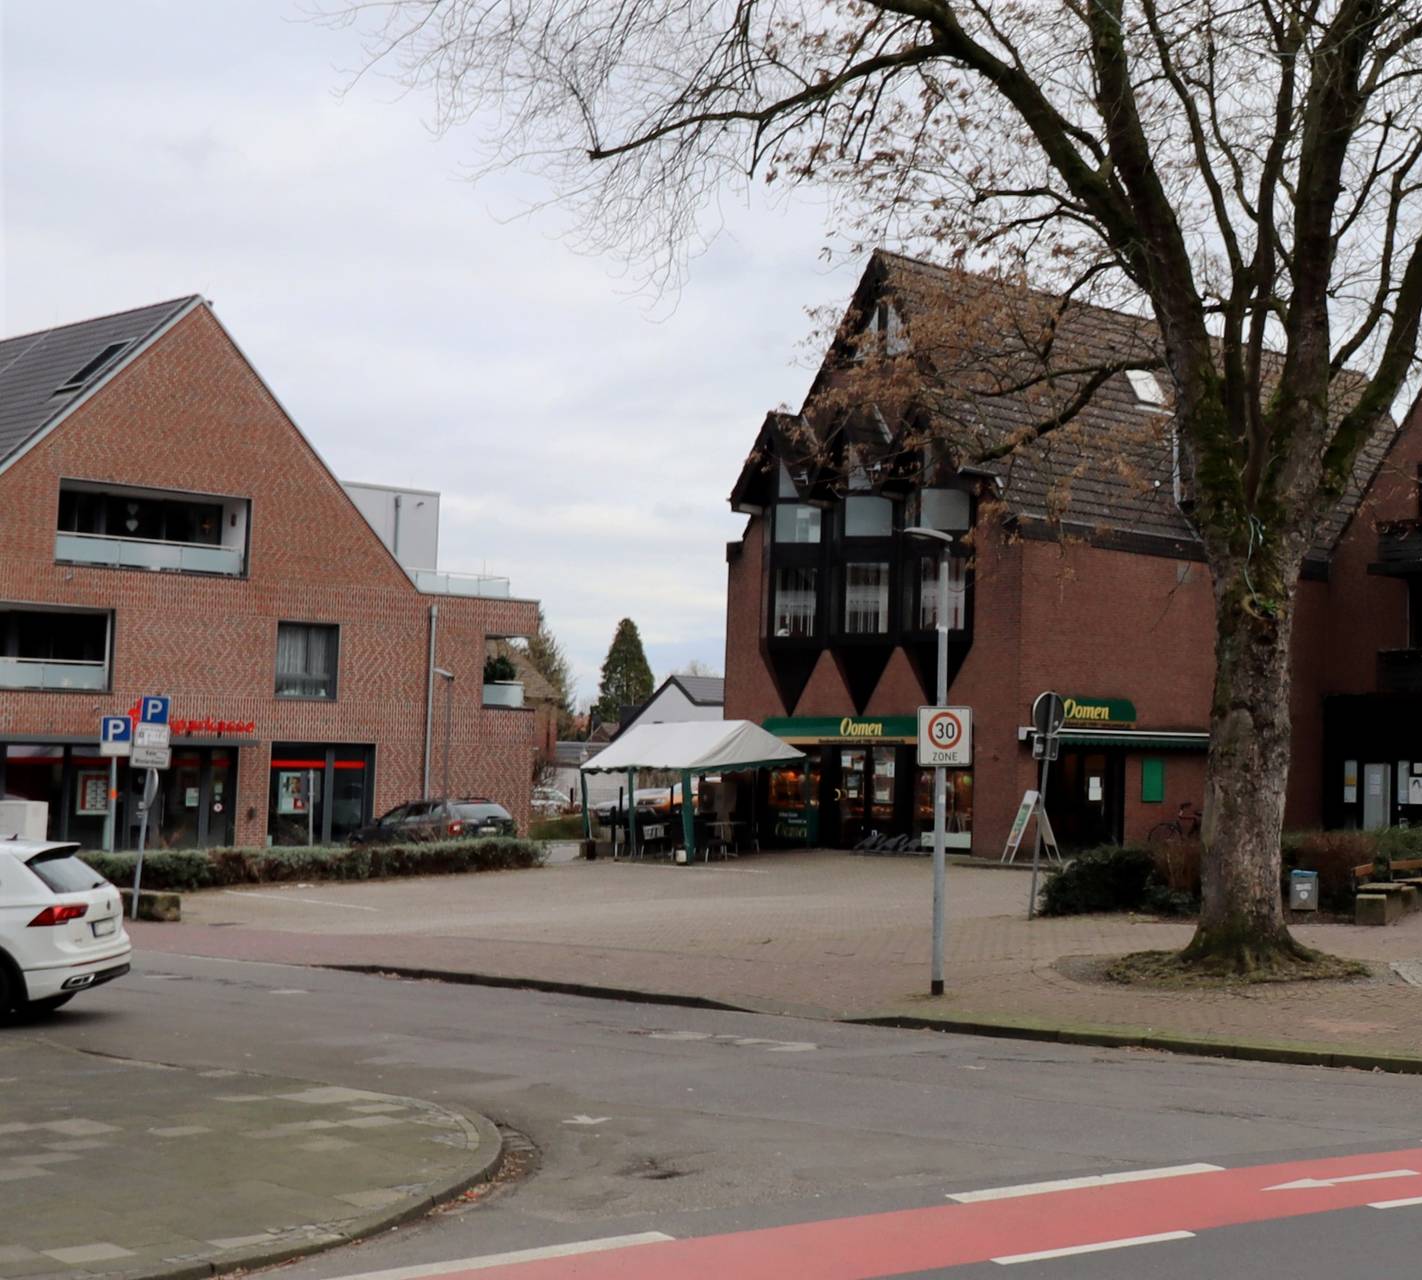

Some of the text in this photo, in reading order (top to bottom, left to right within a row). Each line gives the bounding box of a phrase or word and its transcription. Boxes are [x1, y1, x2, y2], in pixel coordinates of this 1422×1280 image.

[147, 699, 163, 721] P
[1063, 698, 1109, 720] Oomen
[108, 719, 125, 742] P
[840, 717, 883, 736] Oomen
[935, 722, 955, 740] 30
[932, 752, 959, 761] ZONE
